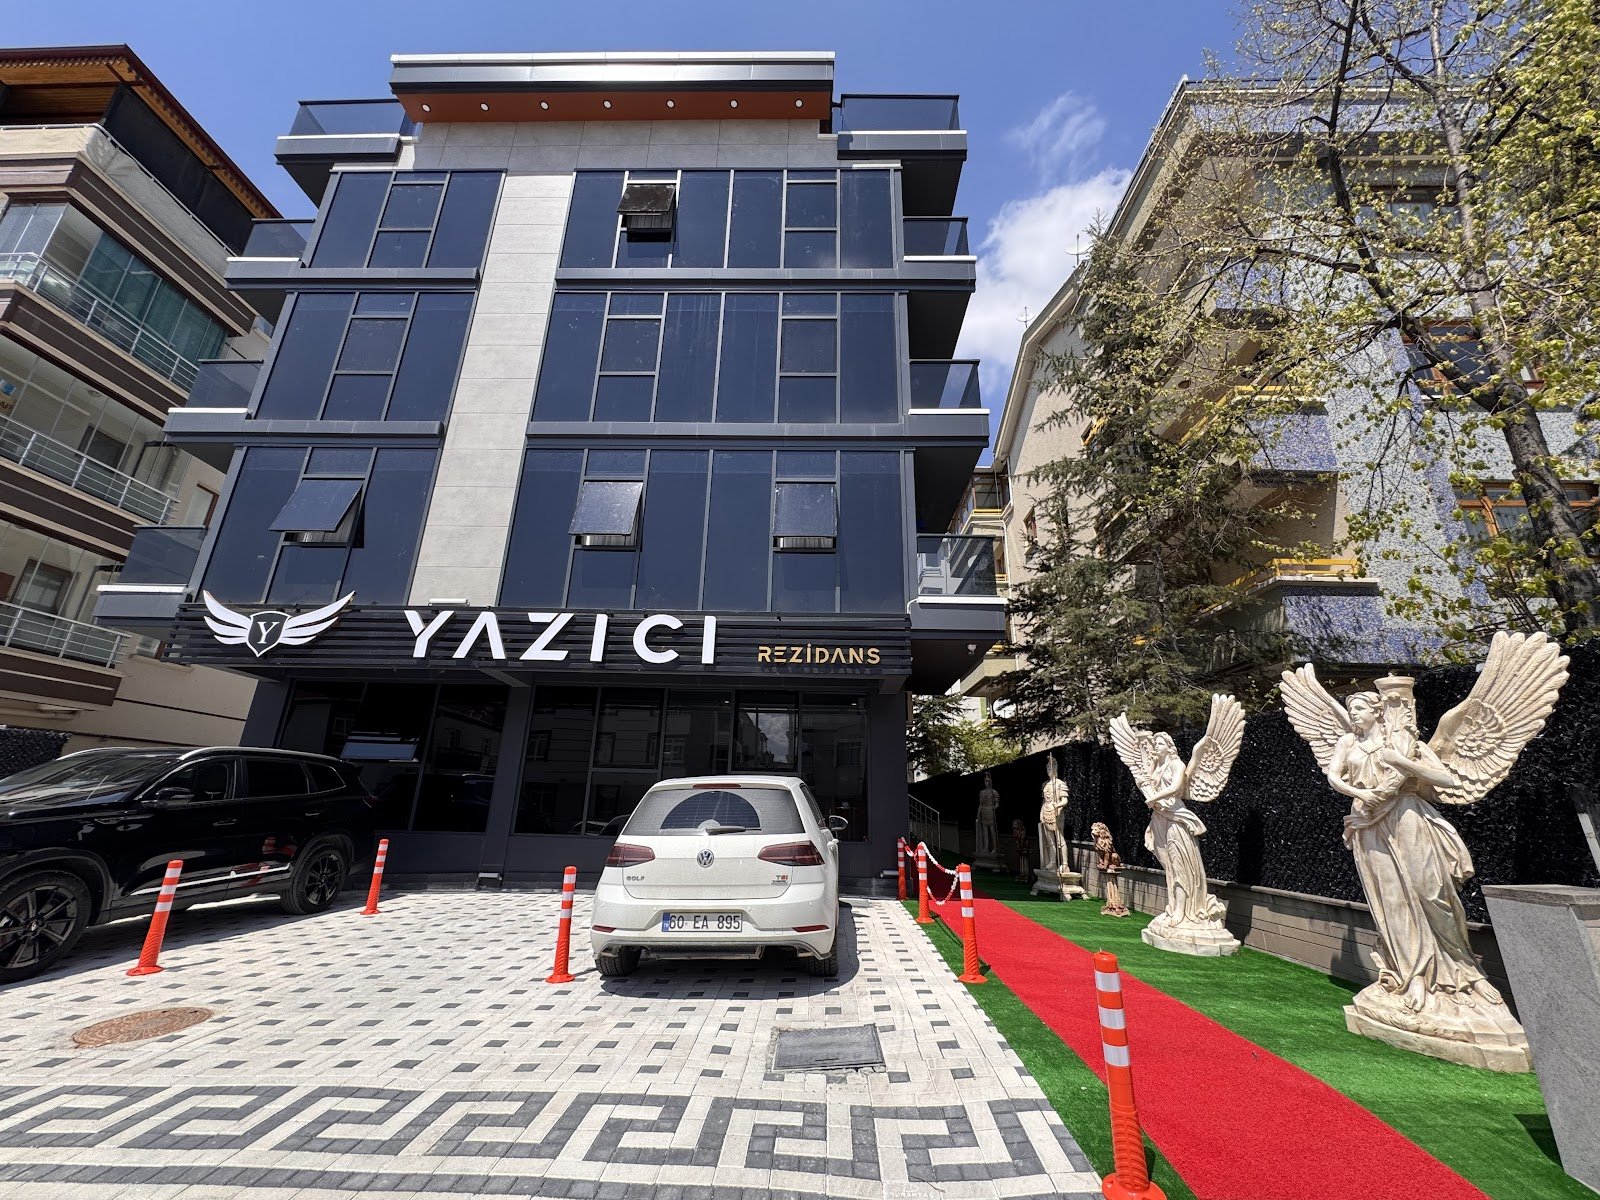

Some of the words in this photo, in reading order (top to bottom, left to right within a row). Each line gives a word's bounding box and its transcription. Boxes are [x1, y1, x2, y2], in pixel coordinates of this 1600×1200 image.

[256, 621, 280, 644] Y
[404, 610, 717, 664] YAZICI
[758, 643, 881, 665] REZİDANS
[669, 915, 685, 930] 60
[693, 915, 709, 930] EA
[717, 915, 741, 930] 895
